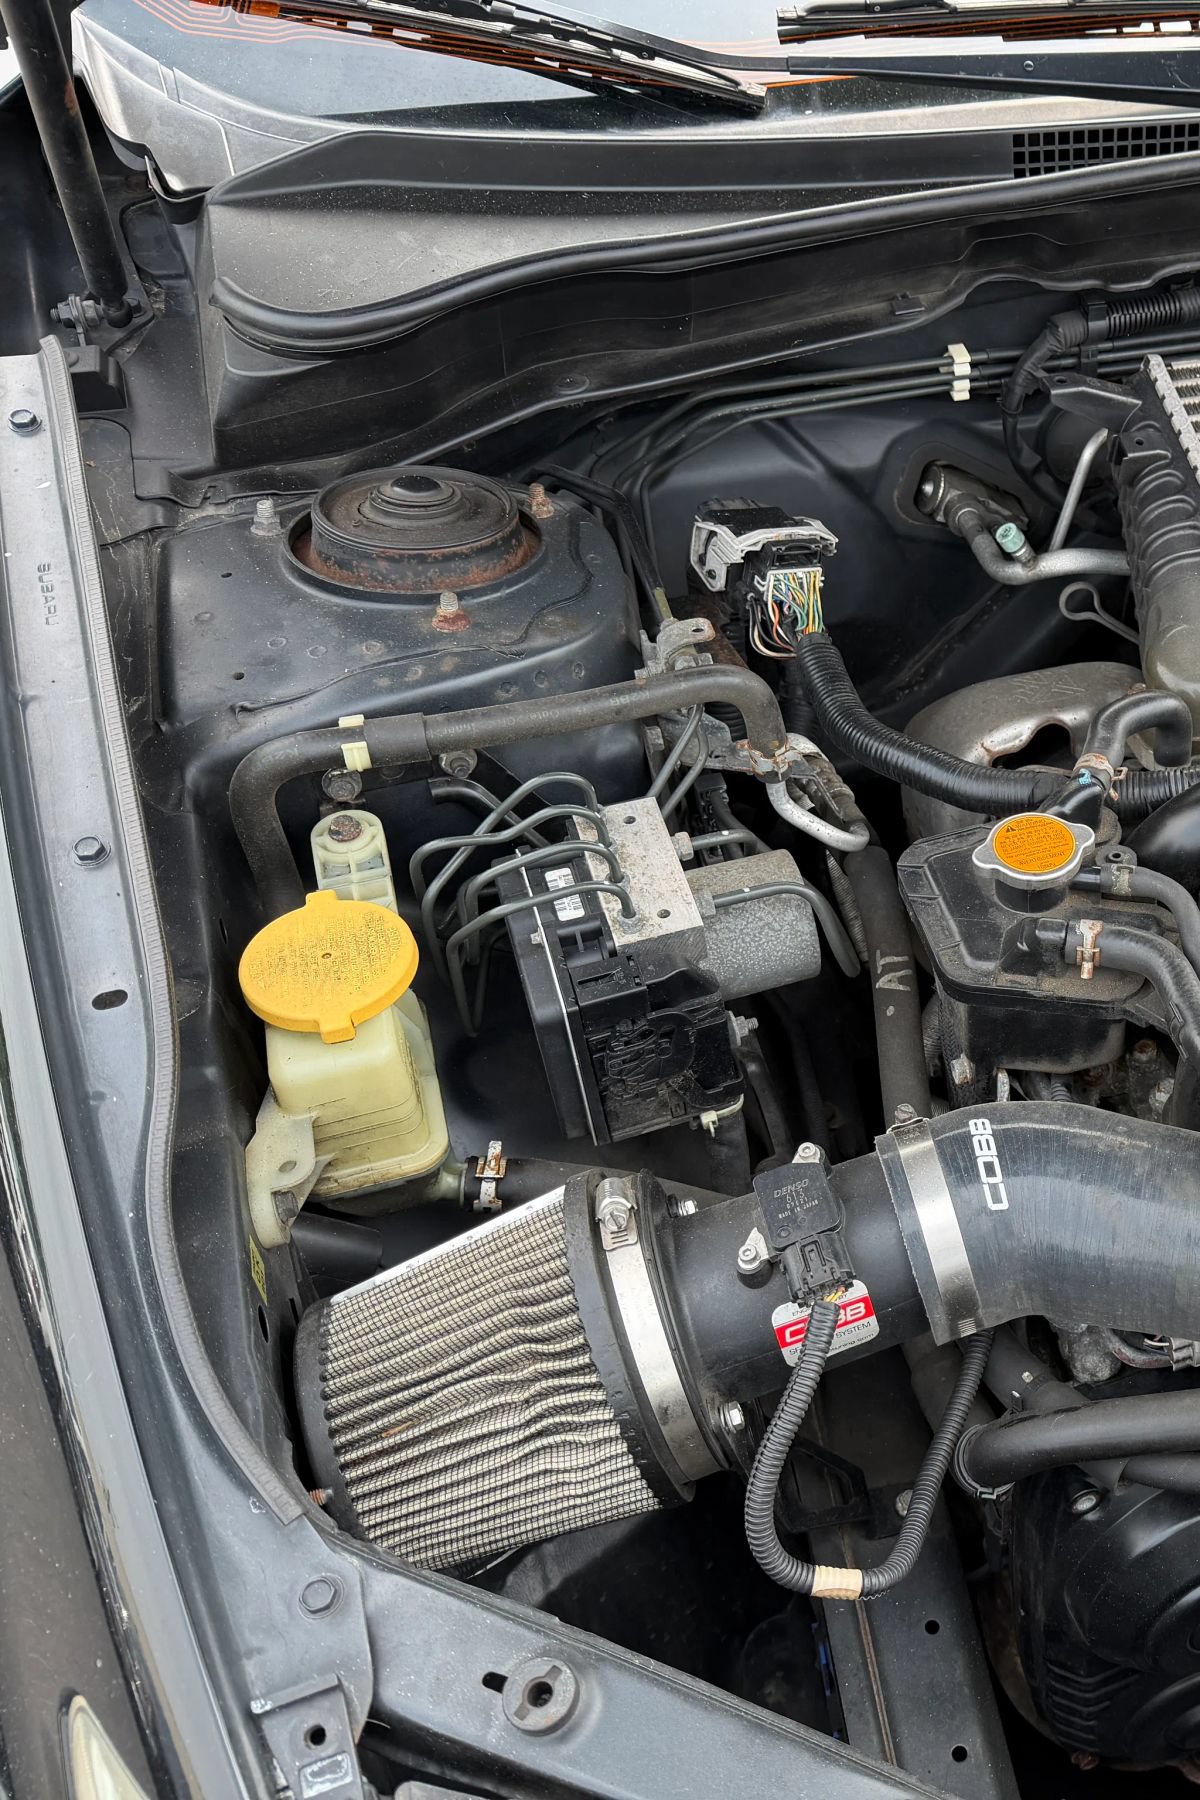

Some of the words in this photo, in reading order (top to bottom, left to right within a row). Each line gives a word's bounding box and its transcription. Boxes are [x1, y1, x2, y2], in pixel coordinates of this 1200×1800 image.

[37, 562, 59, 626] SUBARU
[968, 1118, 1009, 1210] COBB
[773, 1178, 809, 1198] DENSO
[778, 1210, 792, 1219] MADE
[803, 1199, 819, 1210] JAPAN
[784, 1301, 867, 1344] CB
[835, 1321, 872, 1339] SYSTEM
